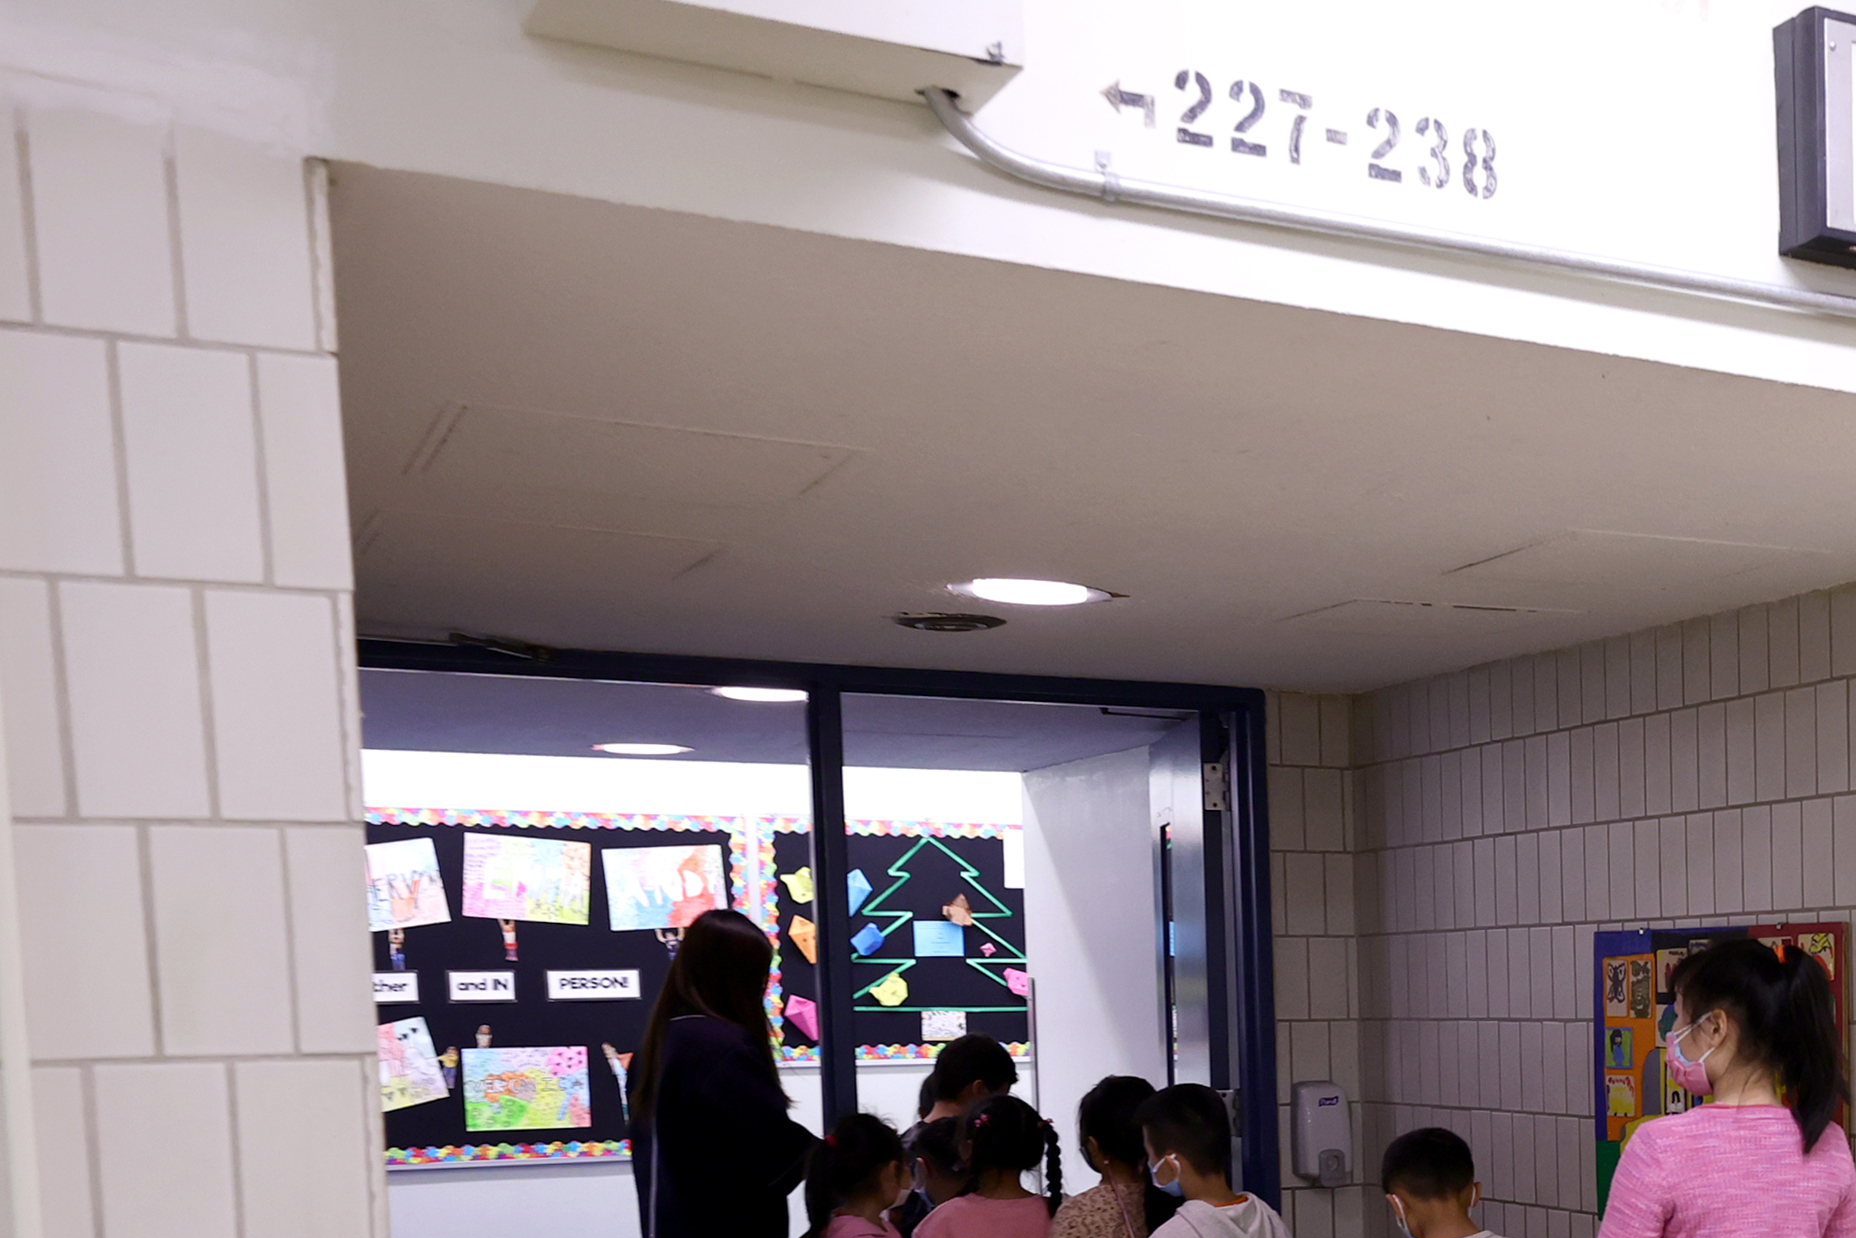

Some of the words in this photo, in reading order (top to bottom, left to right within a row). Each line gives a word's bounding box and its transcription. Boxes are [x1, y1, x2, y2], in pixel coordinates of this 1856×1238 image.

[1174, 69, 1498, 200] 227-238
[457, 978, 487, 991] and
[493, 978, 509, 991] IN
[559, 977, 629, 990] PERSON!
